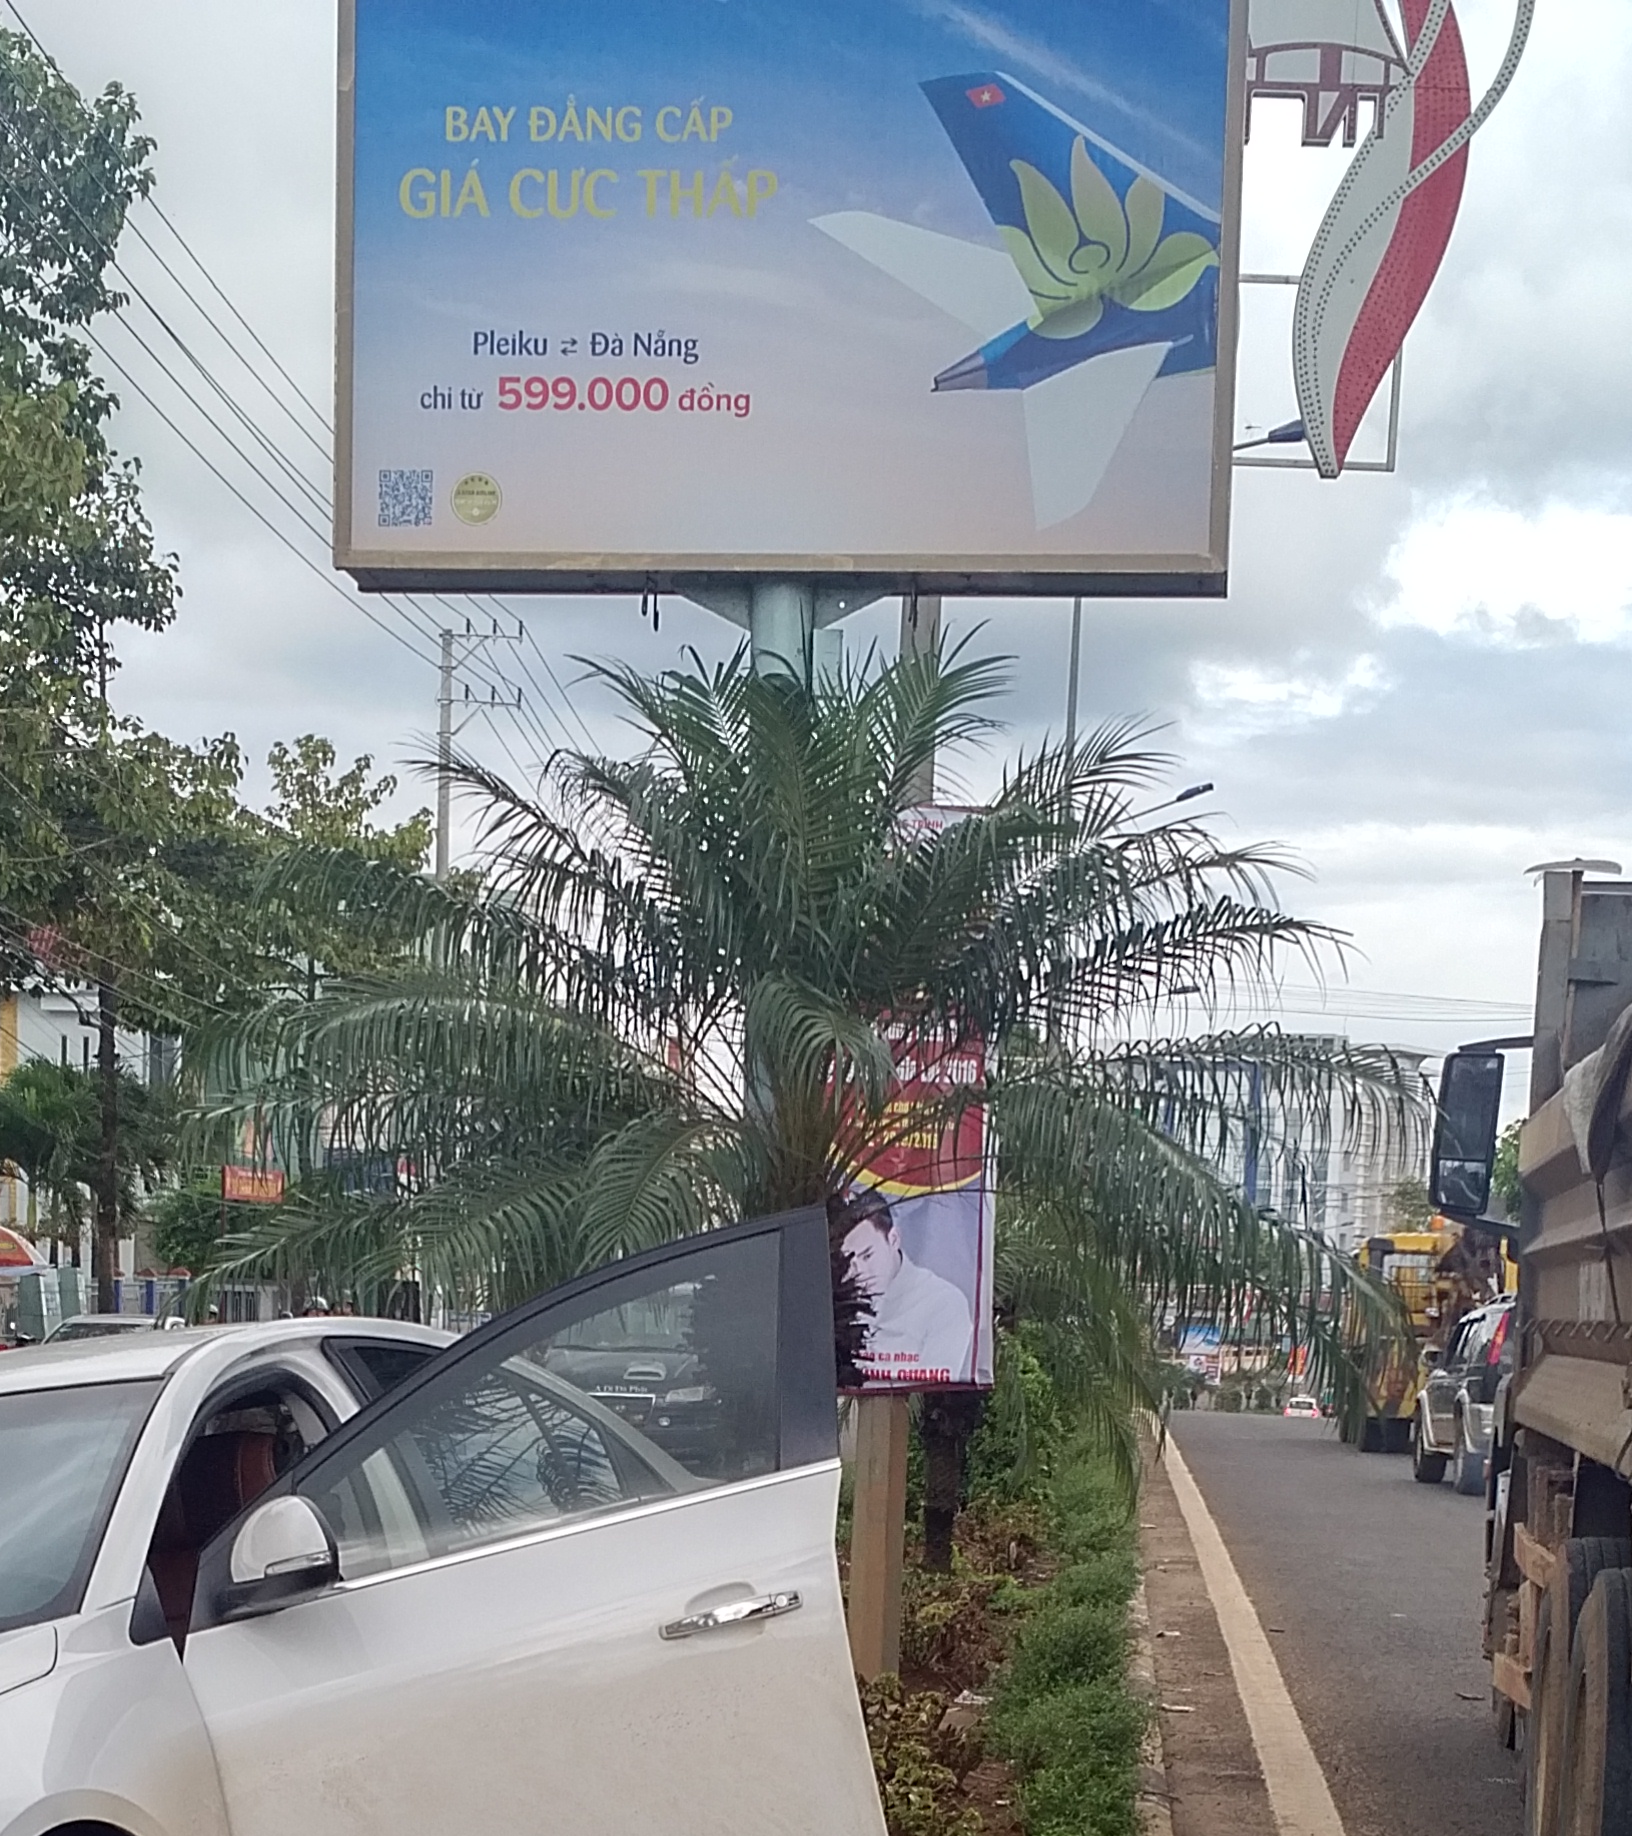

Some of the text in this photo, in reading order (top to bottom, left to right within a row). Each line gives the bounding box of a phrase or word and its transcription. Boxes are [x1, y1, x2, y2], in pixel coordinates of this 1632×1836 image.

[445, 93, 734, 142] BAY ĐẲNG CẤP
[399, 158, 491, 219] GIÁ
[637, 154, 779, 220] THẤP
[473, 329, 700, 364] Pleiku Đà Nẵng
[460, 387, 484, 410] từ
[498, 376, 669, 412] 599.000
[678, 382, 752, 418] đồng
[878, 1352, 890, 1362] ca
